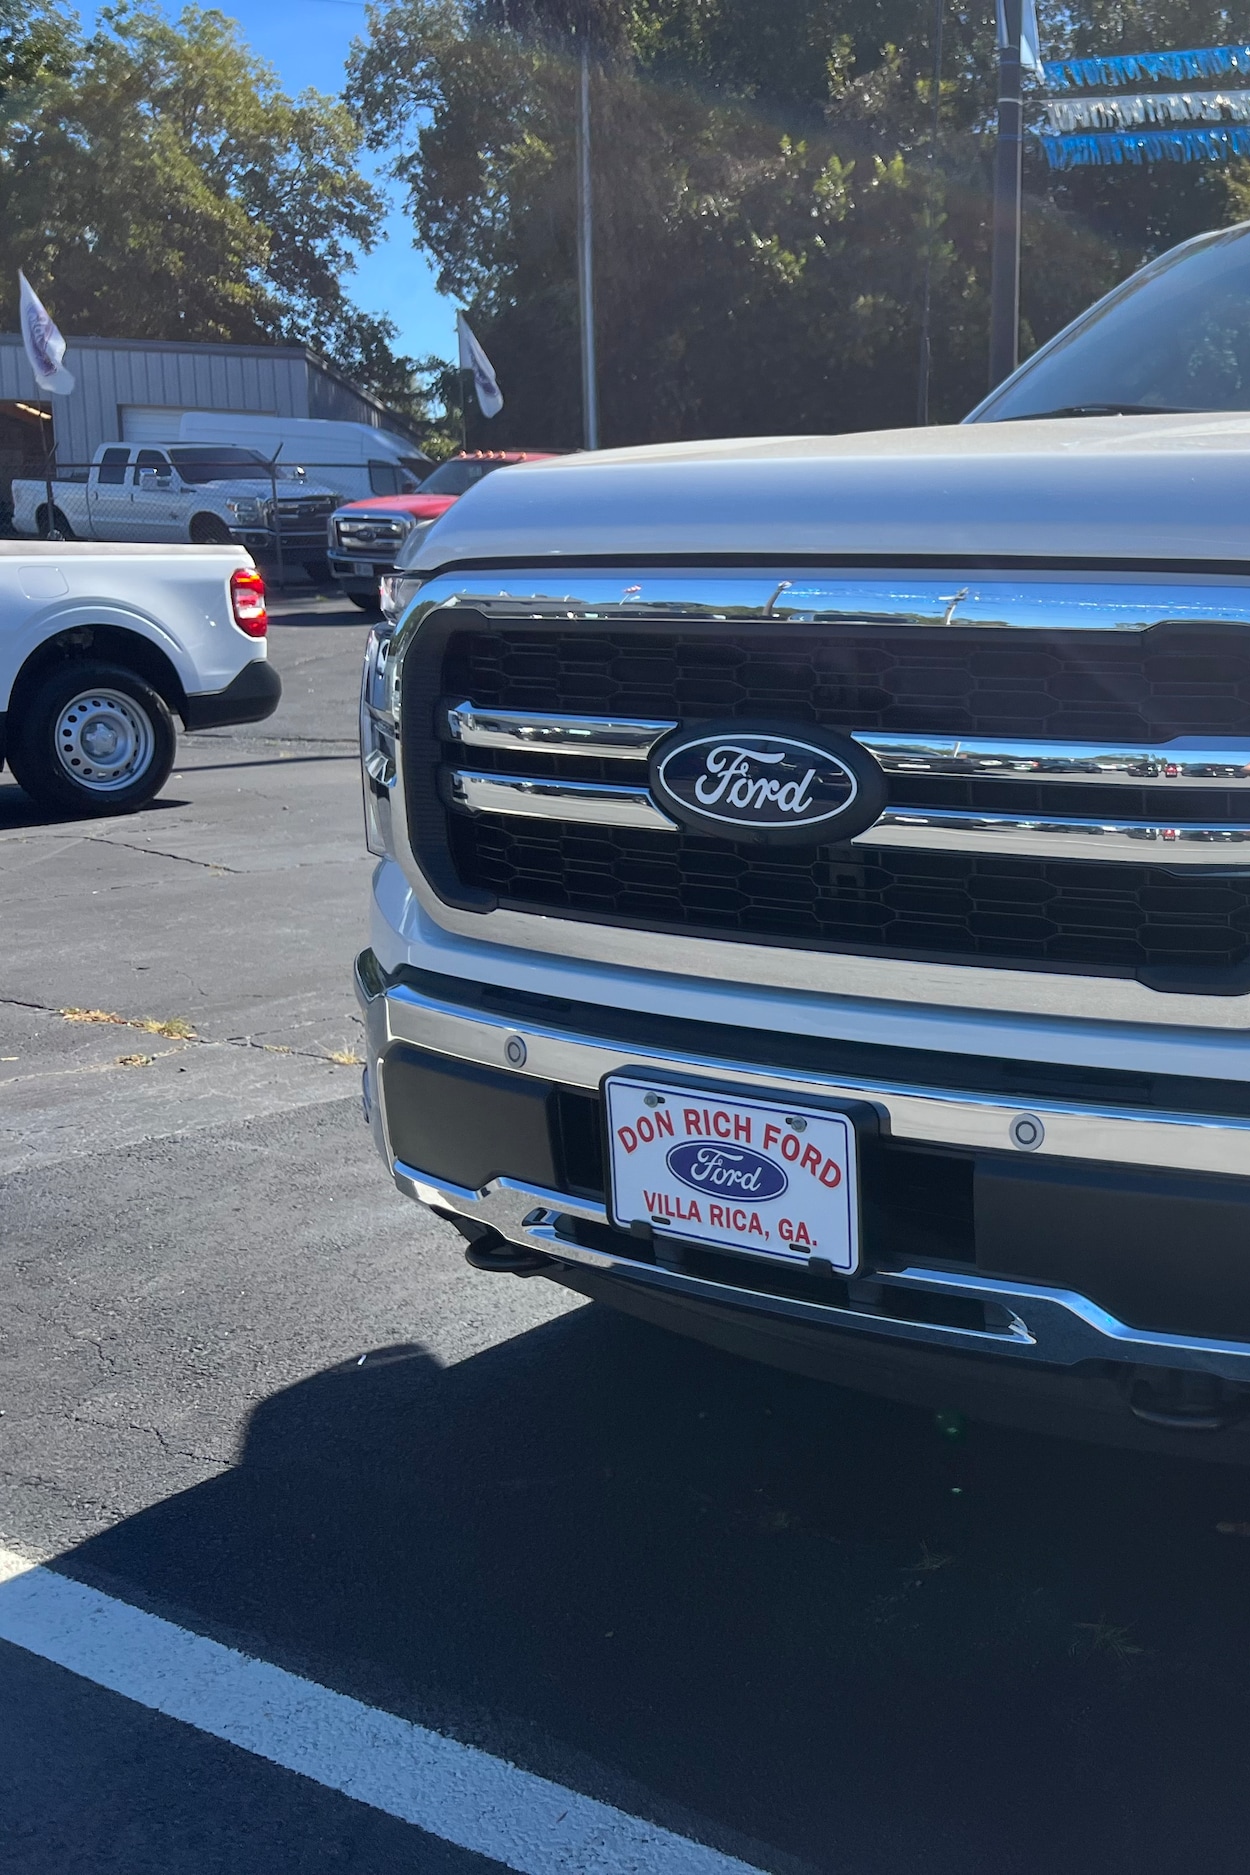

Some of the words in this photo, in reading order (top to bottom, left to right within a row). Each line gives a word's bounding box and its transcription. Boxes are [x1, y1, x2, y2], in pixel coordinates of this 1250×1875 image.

[695, 745, 816, 813] Ford
[617, 1109, 675, 1154] DON
[683, 1108, 751, 1143] RICH
[763, 1123, 842, 1189] FORD
[690, 1147, 762, 1192] Ford
[643, 1190, 702, 1223] VILLA
[709, 1203, 770, 1241] RICA,
[778, 1218, 818, 1247] GA.
